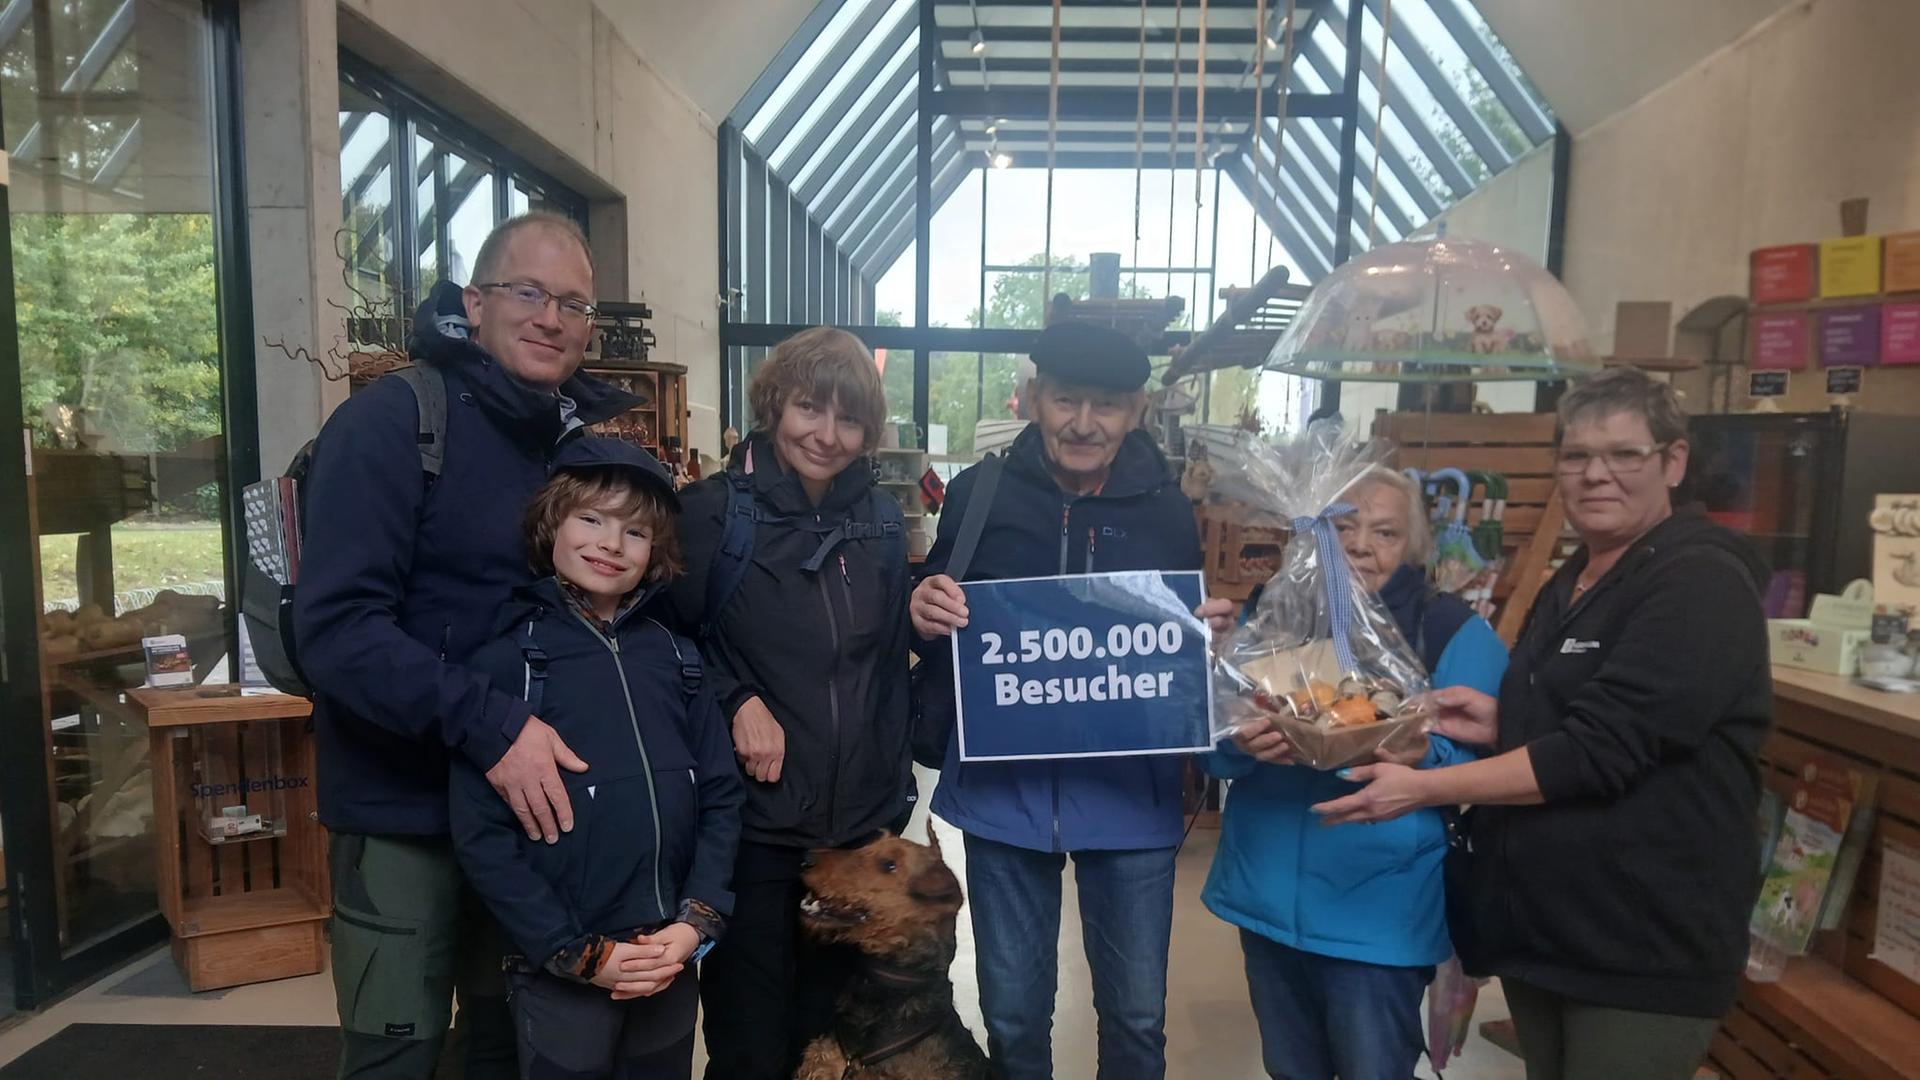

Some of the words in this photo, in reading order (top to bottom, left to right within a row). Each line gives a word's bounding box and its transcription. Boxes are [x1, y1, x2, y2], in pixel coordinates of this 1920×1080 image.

[980, 621, 1183, 664] 2.500.000
[995, 665, 1174, 706] Besucher
[190, 773, 308, 798] Spendenbox
